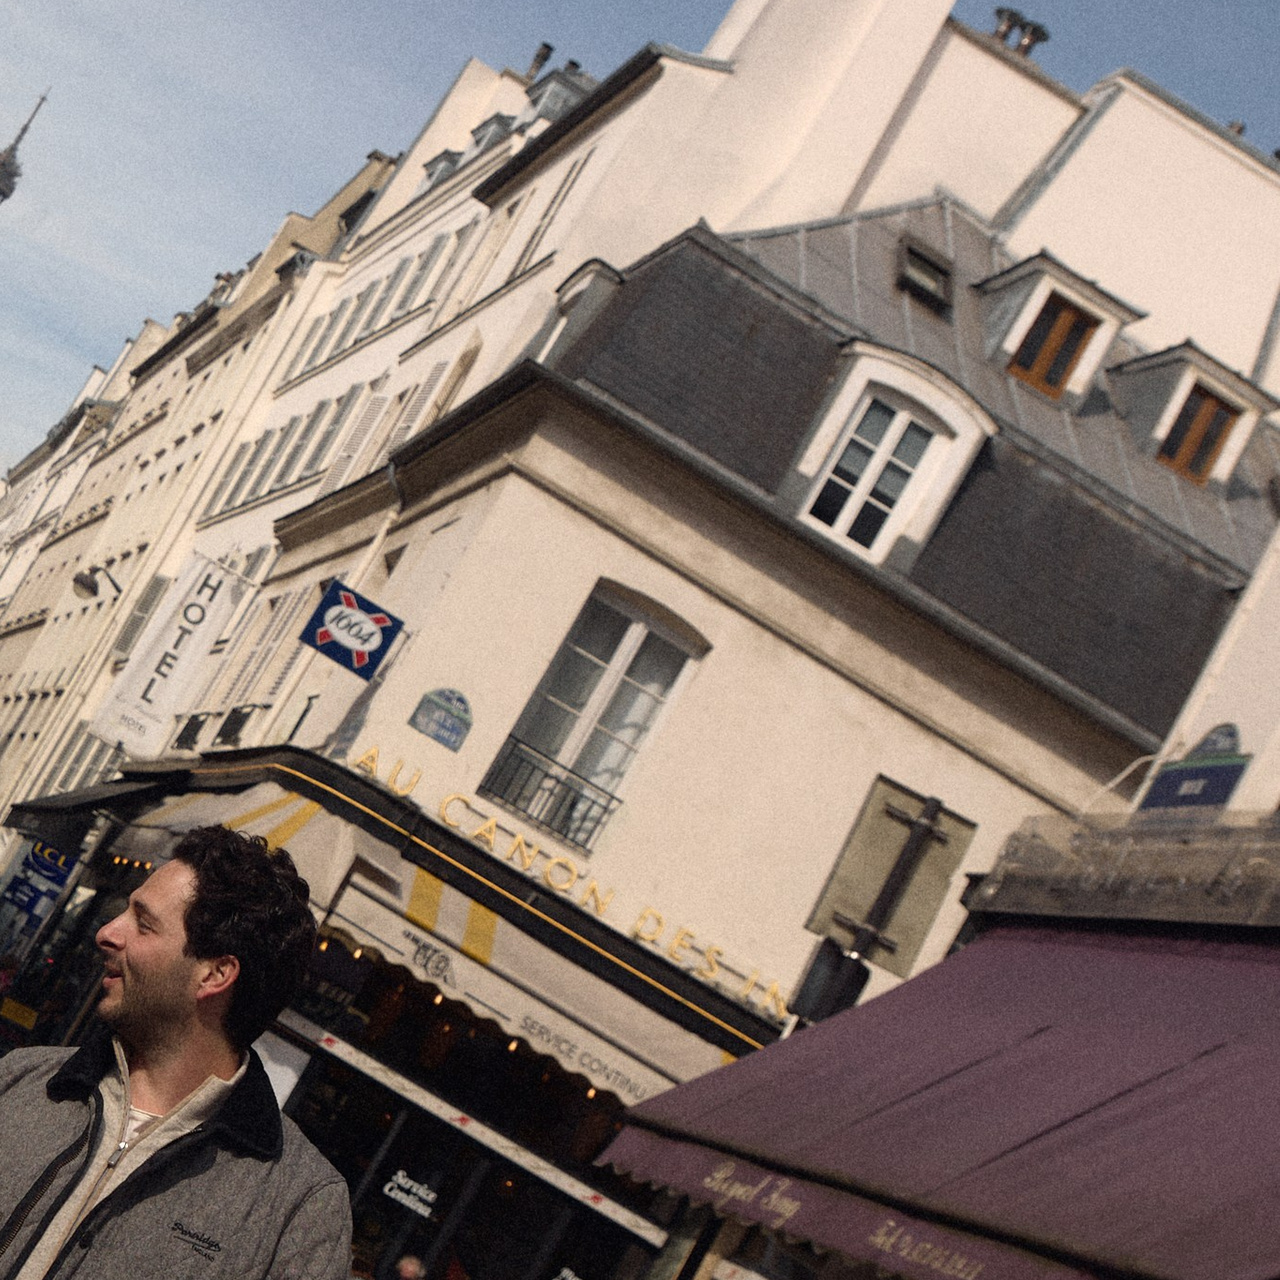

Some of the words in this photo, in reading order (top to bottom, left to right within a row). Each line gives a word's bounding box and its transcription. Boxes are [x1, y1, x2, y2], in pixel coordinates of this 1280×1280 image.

[140, 572, 223, 704] HOTEL
[329, 609, 377, 646] 1664
[33, 841, 69, 874] LCL
[349, 744, 422, 797] AU
[438, 792, 616, 917] CANON
[631, 905, 725, 981] DES
[520, 1014, 578, 1061] SERVICE
[579, 1050, 648, 1101] CONTINU
